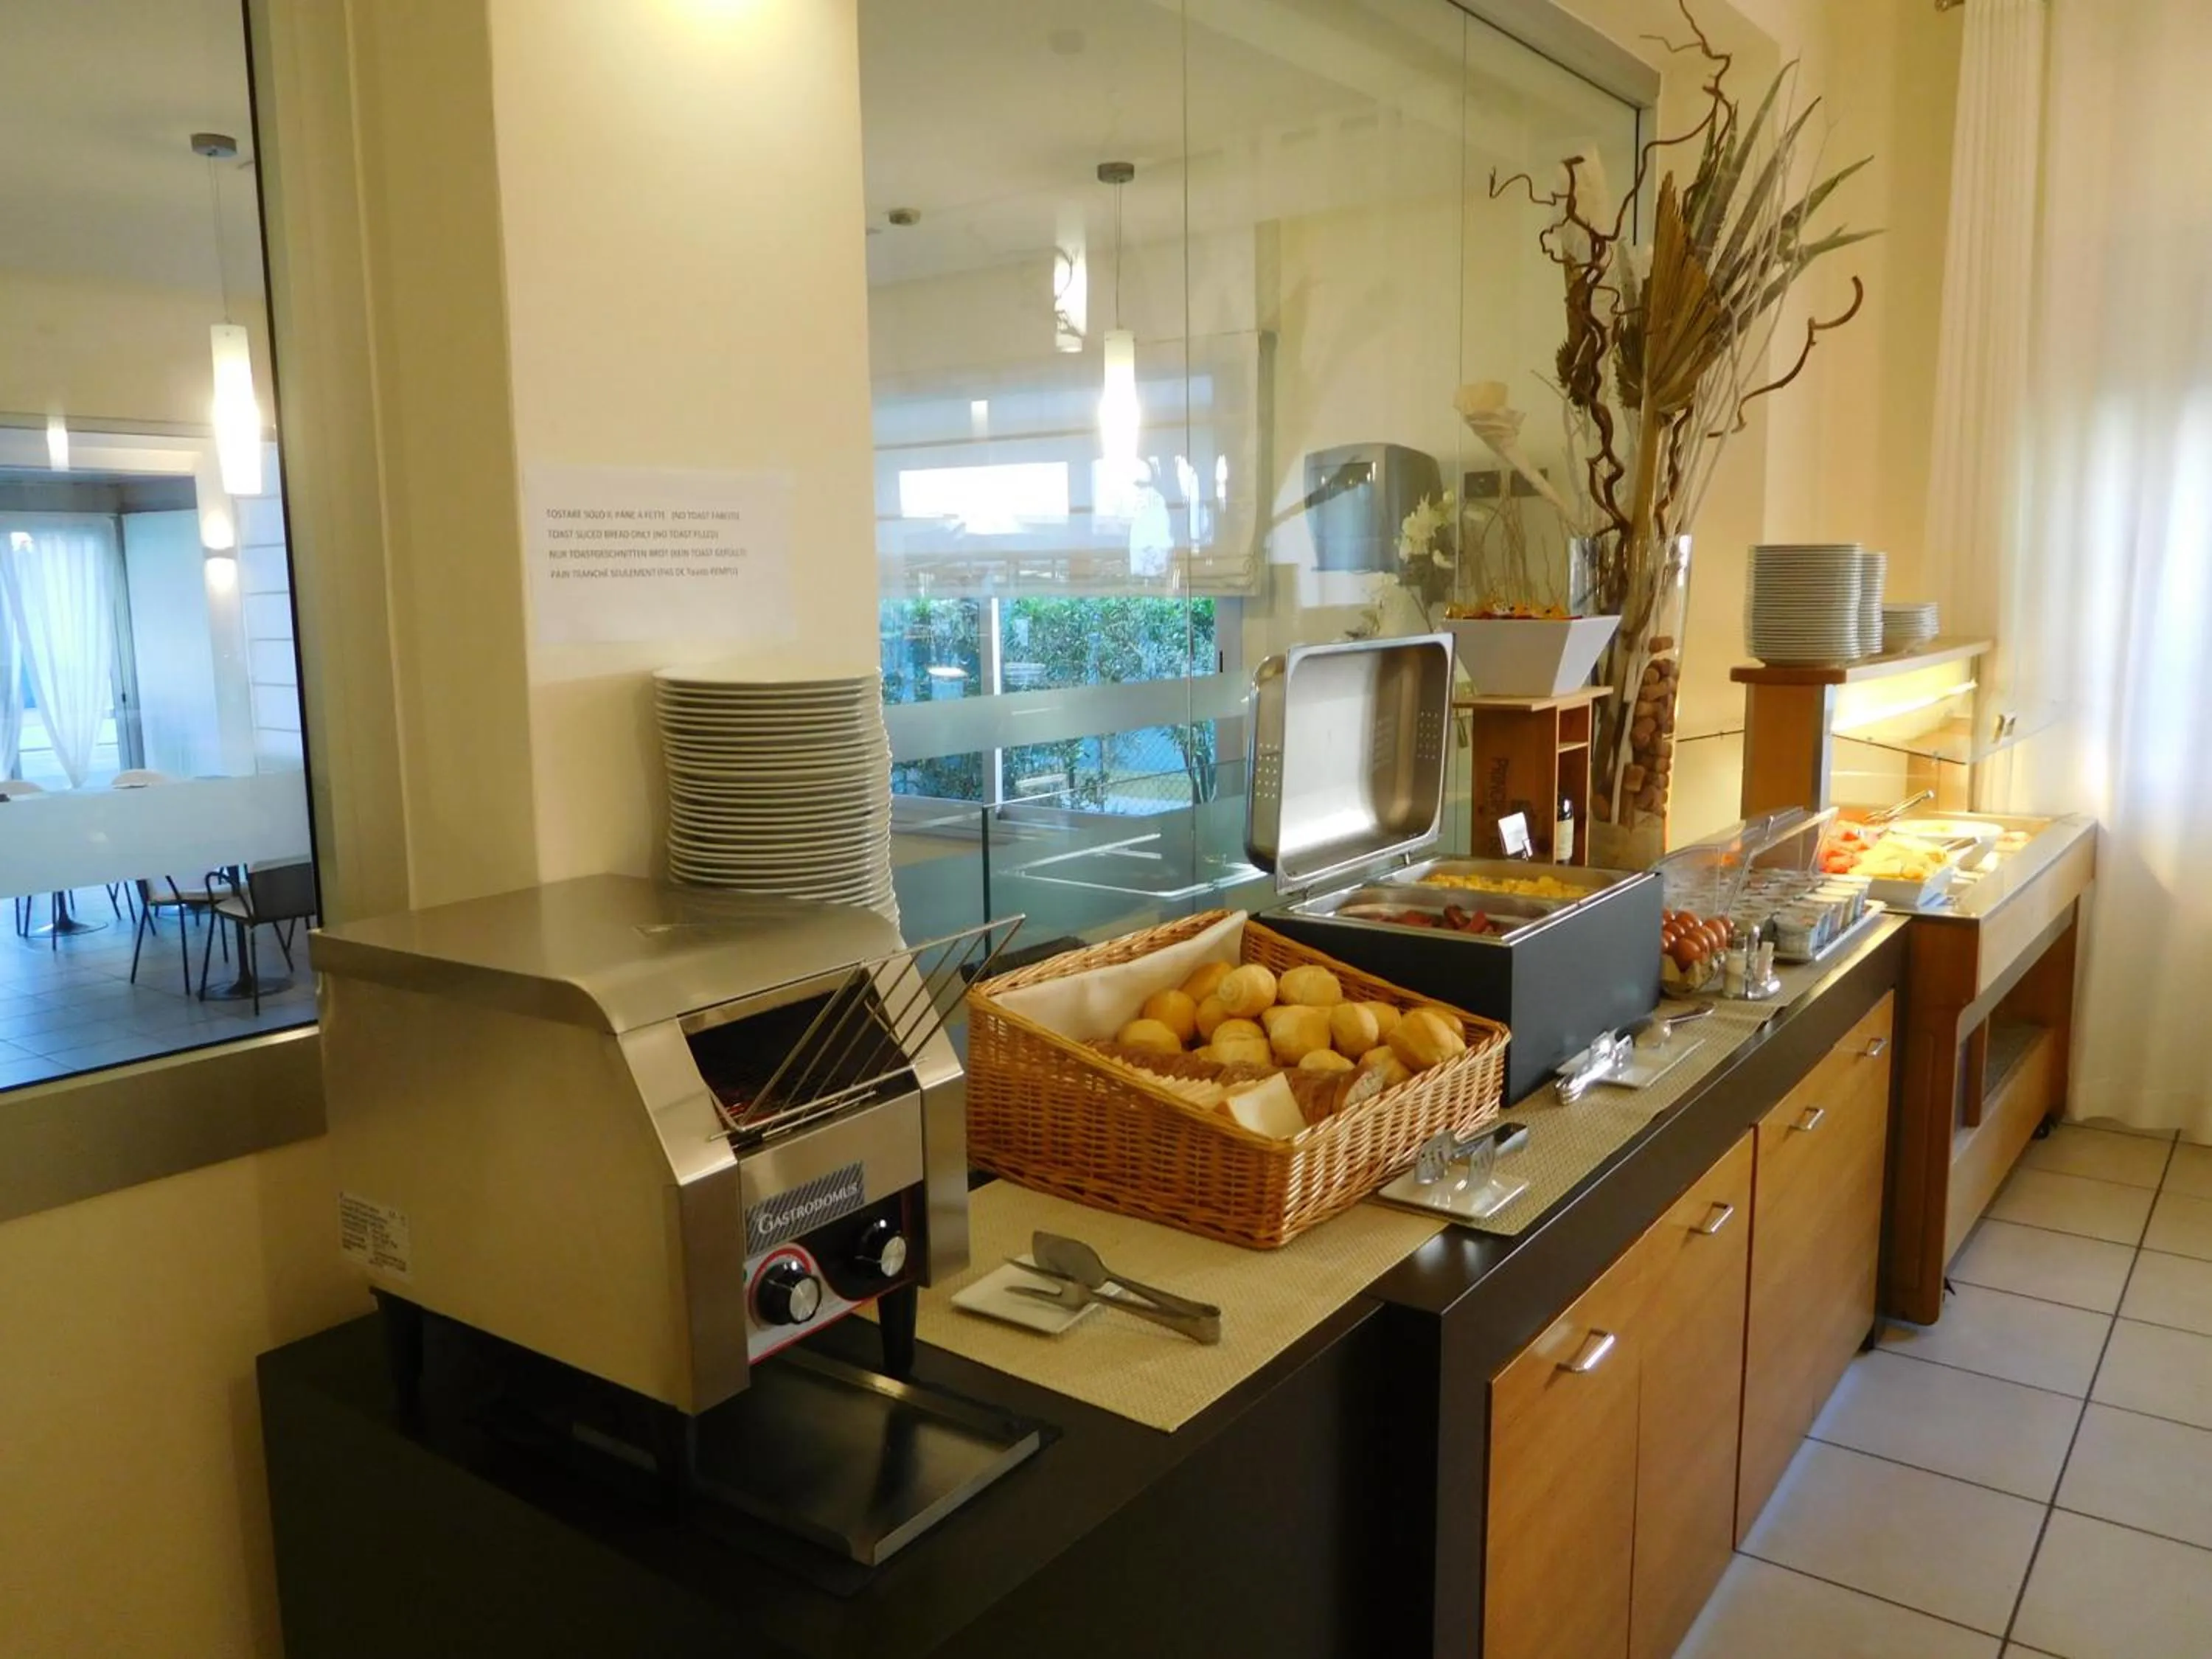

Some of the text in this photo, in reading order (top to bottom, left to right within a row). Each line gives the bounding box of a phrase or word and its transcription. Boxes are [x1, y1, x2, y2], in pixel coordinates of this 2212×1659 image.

[582, 509, 606, 519] SOLO
[615, 510, 635, 519] PANE
[548, 530, 573, 538] TOAST
[575, 530, 602, 539] SLICED
[604, 530, 630, 539] BREAD
[669, 530, 692, 539] TOAST
